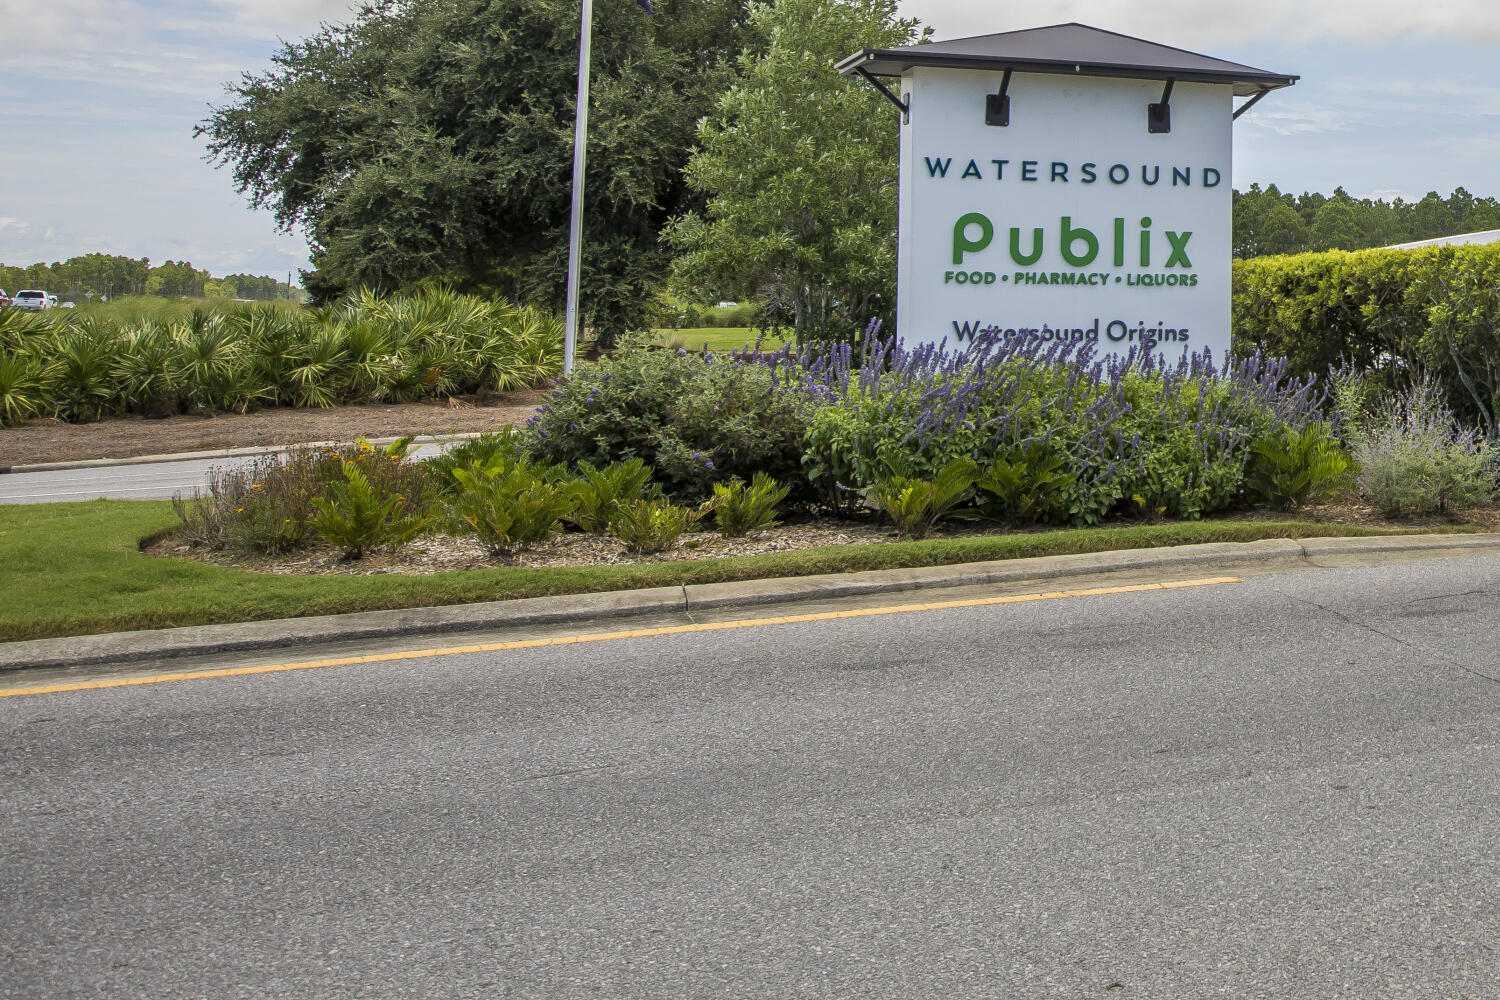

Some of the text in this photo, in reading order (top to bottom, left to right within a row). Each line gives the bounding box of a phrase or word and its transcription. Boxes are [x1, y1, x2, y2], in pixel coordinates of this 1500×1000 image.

[924, 156, 1222, 187] WATERSOUND
[952, 212, 1193, 267] Publix
[944, 271, 1198, 287] FOOD PHARMACY LIQUORS
[952, 319, 1189, 349] Watesound Origins
